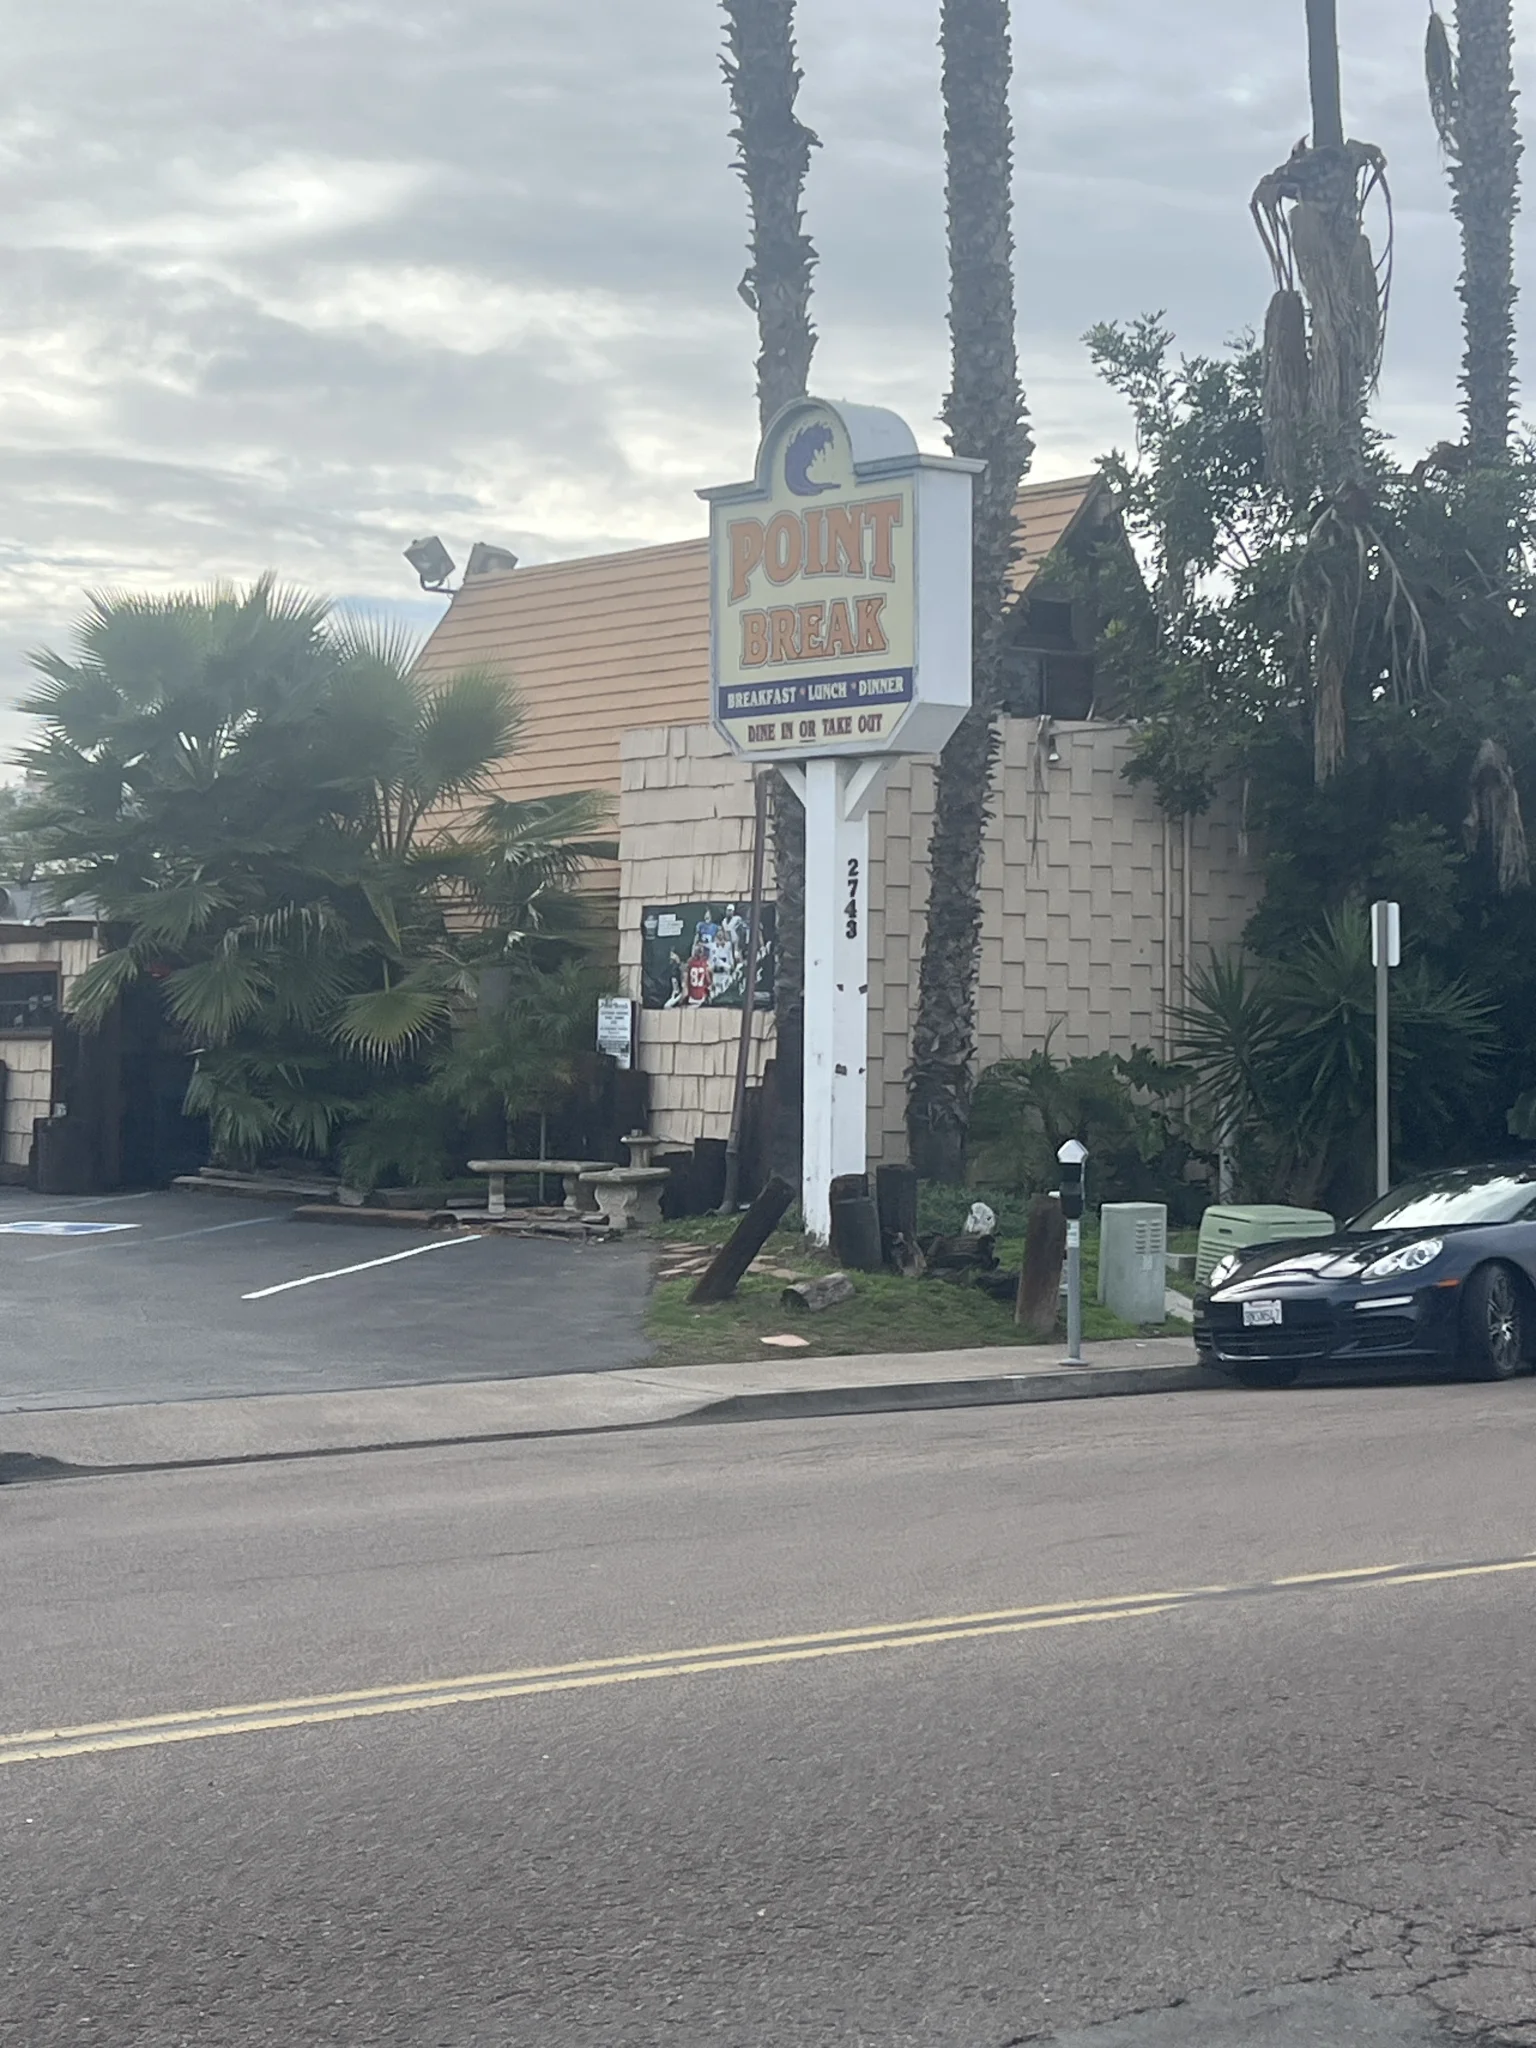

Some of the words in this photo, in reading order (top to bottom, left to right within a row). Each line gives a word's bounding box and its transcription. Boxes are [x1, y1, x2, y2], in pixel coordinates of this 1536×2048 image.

[728, 495, 902, 604] POINT
[740, 595, 888, 669] BREAK
[727, 687, 797, 709] BREAKFAST
[808, 682, 847, 701] LUNCH
[858, 676, 904, 697] DINNER
[747, 722, 776, 743] DINE
[781, 721, 793, 739] IN
[800, 719, 816, 738] OR
[822, 716, 853, 736] TAKE
[858, 713, 883, 733] OUT
[844, 858, 859, 939] 2743
